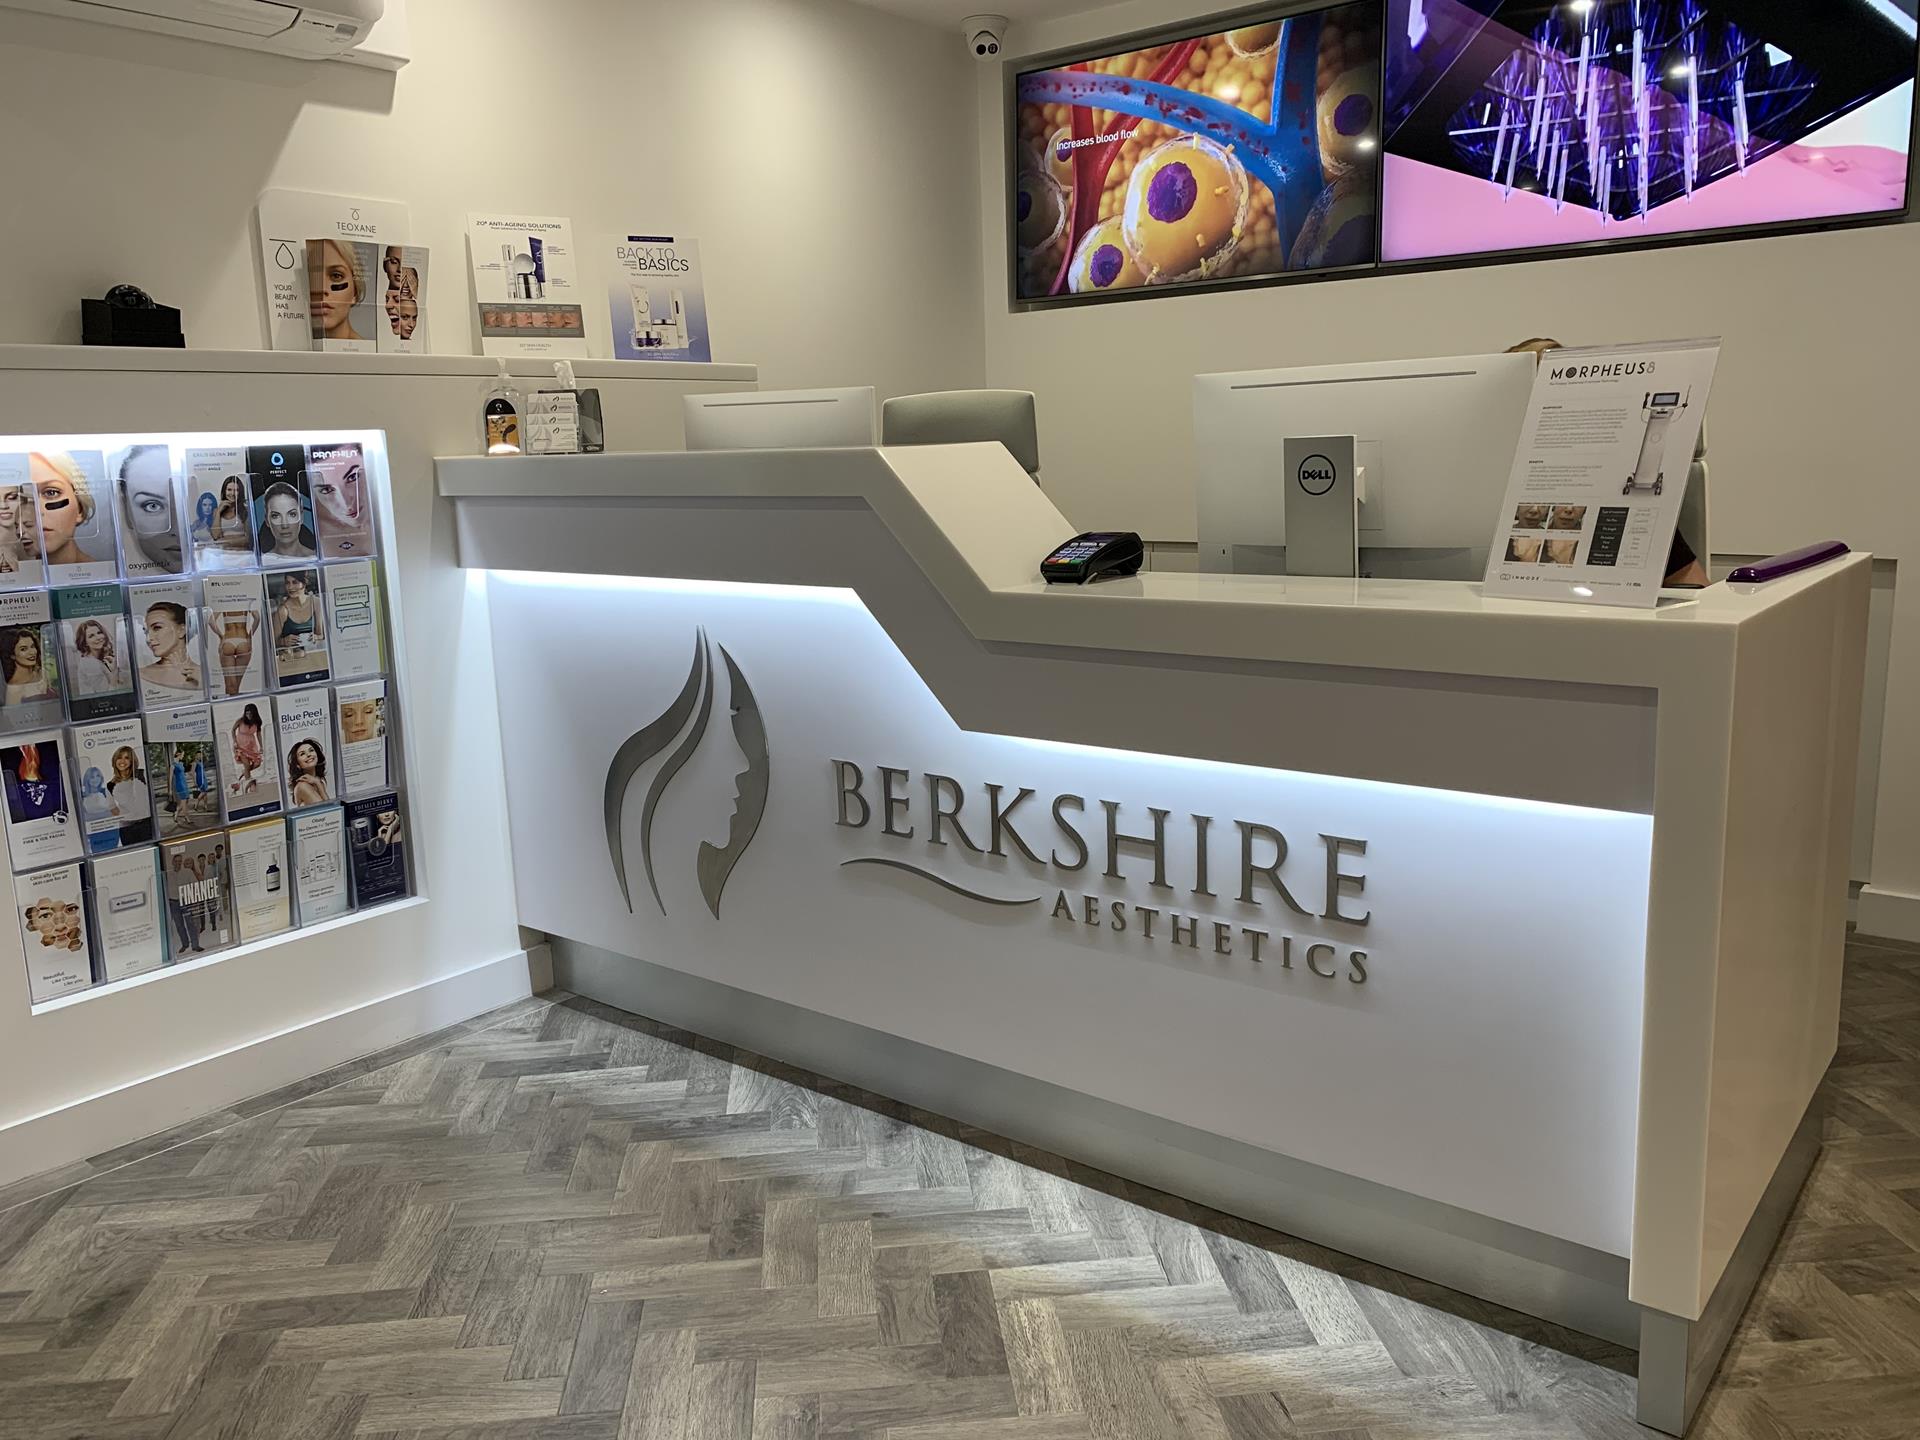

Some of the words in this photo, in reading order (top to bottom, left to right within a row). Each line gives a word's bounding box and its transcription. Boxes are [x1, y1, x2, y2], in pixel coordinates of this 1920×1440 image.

[1056, 137, 1095, 151] Increases
[1096, 131, 1119, 144] blood
[1120, 129, 1140, 140] flow
[336, 221, 376, 233] TEOXANE
[528, 222, 562, 230] SOLUTIONS
[616, 246, 653, 260] BACK
[656, 247, 675, 261] TO
[638, 257, 689, 272] BASICS
[1302, 469, 1332, 481] DELL
[128, 561, 171, 571] oxygenetix
[281, 710, 302, 723] Blue
[302, 708, 323, 720] Peel
[82, 729, 102, 738] ULTRA
[102, 726, 122, 736] FEMME
[166, 723, 184, 731] FREEZE
[185, 720, 199, 728] AWAY
[200, 718, 208, 726] FAT
[281, 717, 324, 733] RADIANCE
[49, 832, 66, 840] FACIAL
[831, 758, 1371, 927] BERKSHIRE
[178, 877, 220, 907] FINANCE
[1051, 889, 1369, 985] AESTHETICS
